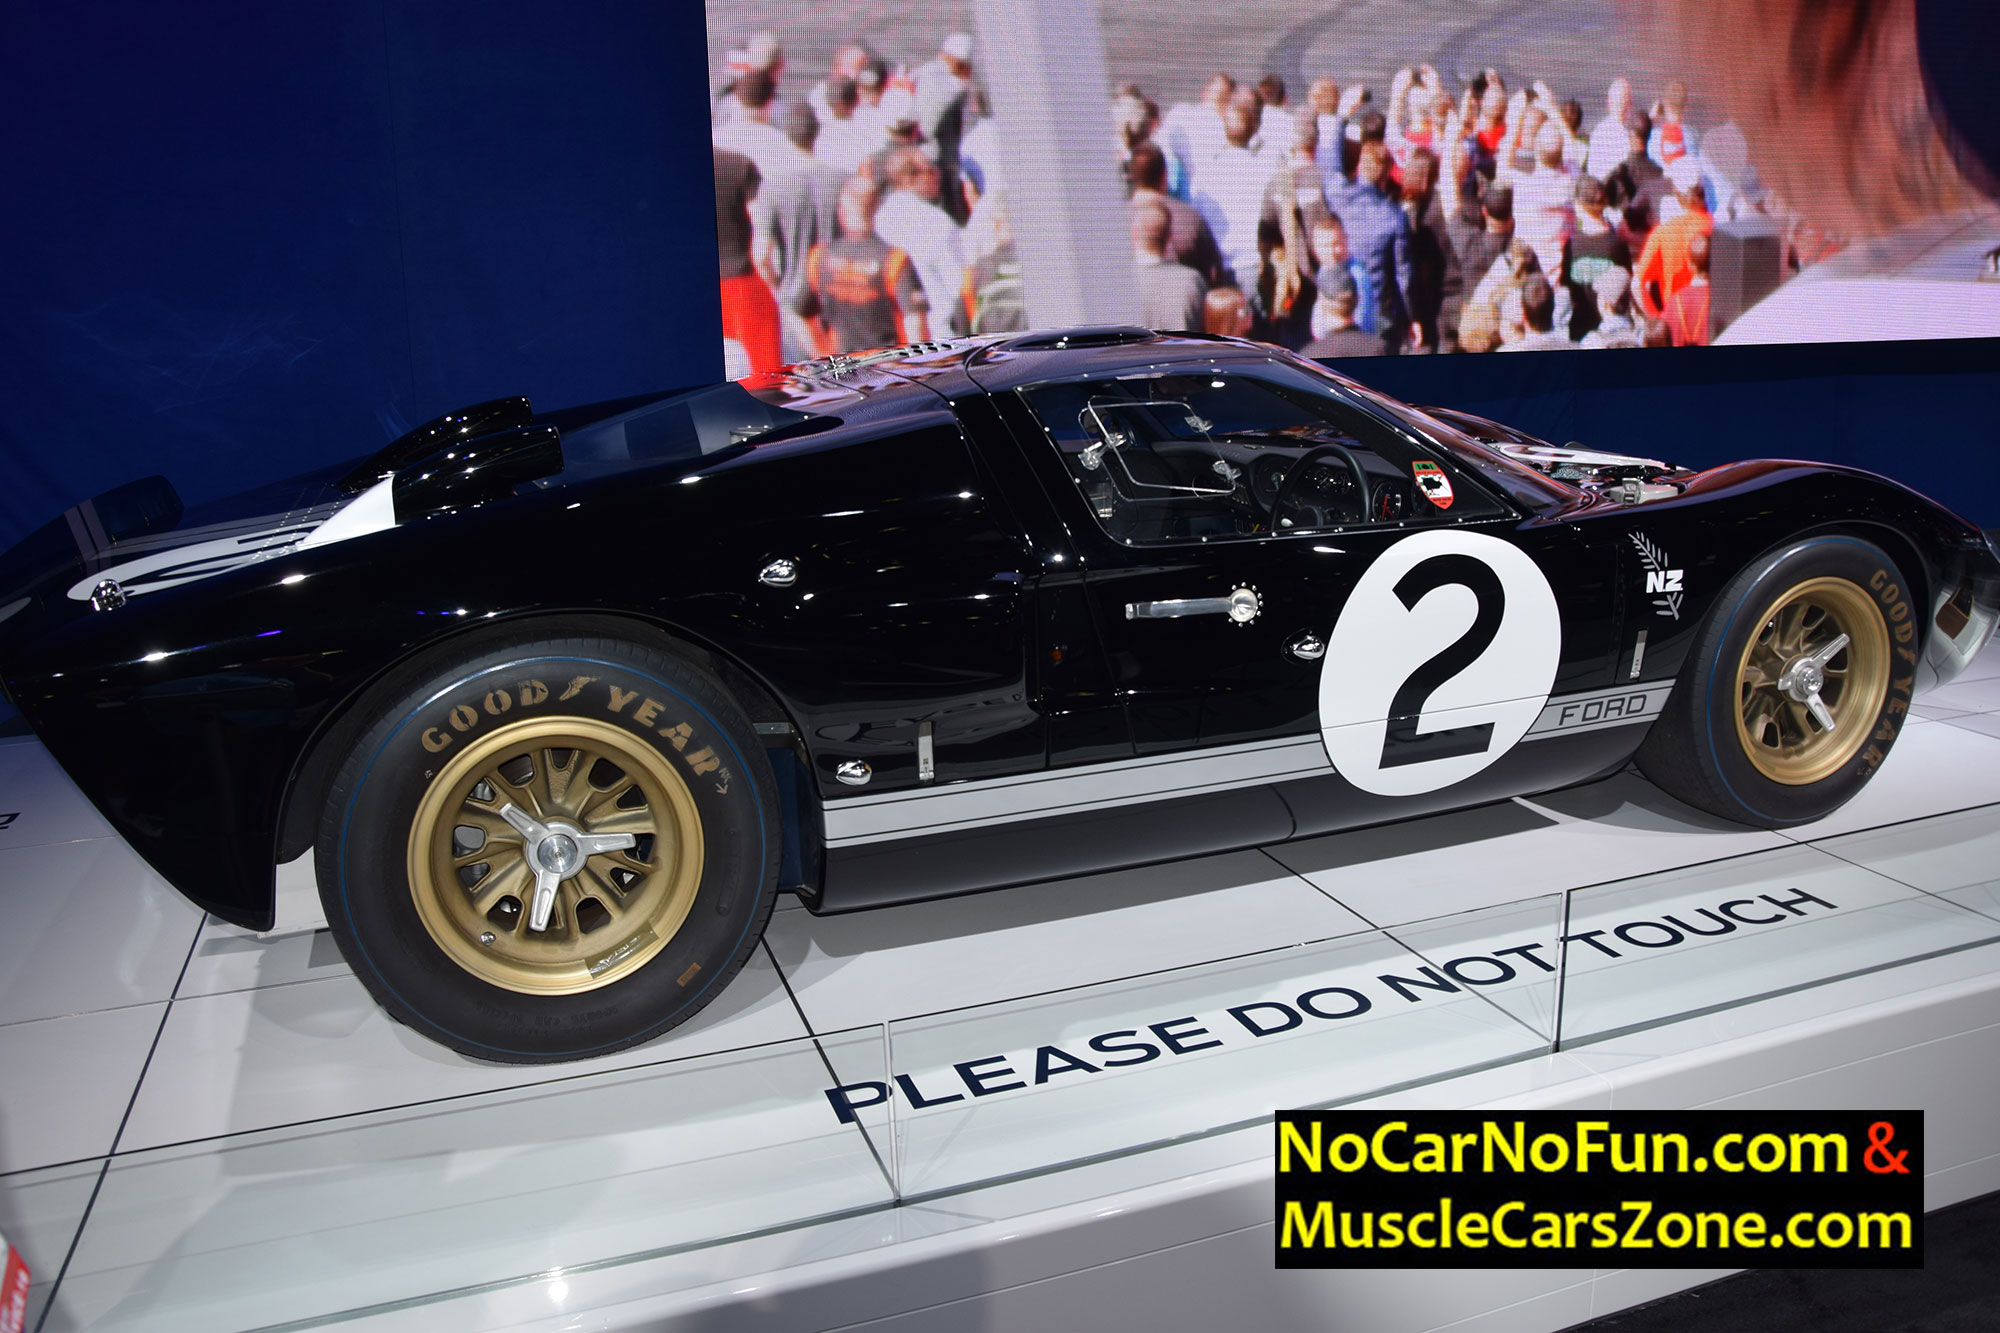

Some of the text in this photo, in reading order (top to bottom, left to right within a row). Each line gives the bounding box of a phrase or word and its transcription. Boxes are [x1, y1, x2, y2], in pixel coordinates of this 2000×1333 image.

[421, 679, 721, 777] GOOD YEAR
[1378, 553, 1506, 770] 2
[1558, 694, 1648, 727] FORD
[1861, 568, 1914, 768] GOOD YEAR
[824, 887, 1839, 1125] PLEASE DO NOT TOUCH
